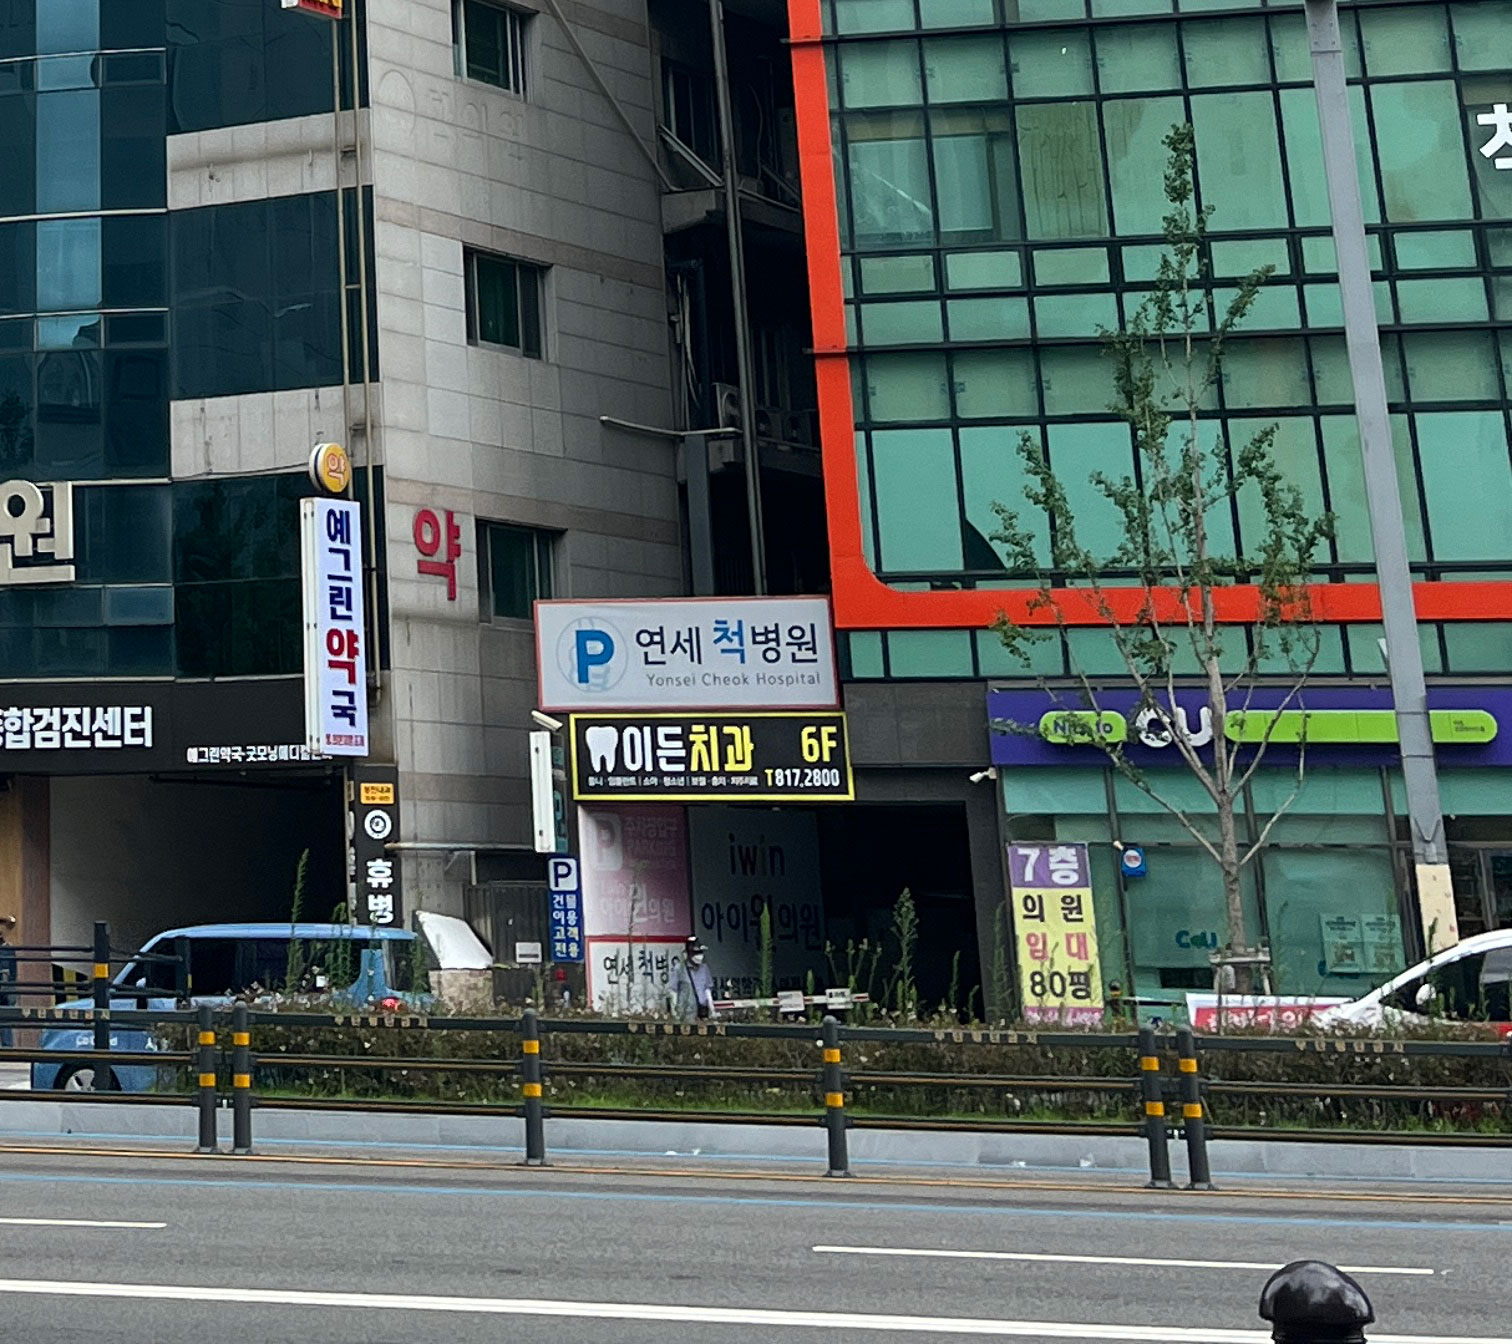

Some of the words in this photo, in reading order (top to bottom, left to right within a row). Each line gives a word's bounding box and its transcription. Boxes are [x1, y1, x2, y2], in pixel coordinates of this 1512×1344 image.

[412, 507, 462, 602] 약
[325, 508, 359, 727] 예그린약국
[646, 672, 696, 688] Yonsei
[703, 671, 749, 687] Cheok
[756, 670, 821, 687] Hospital
[623, 725, 754, 773] 이든치과
[801, 726, 837, 763] 6F
[553, 862, 573, 889] P
[1017, 846, 1080, 885] 7층
[1030, 970, 1092, 1000] 80평
